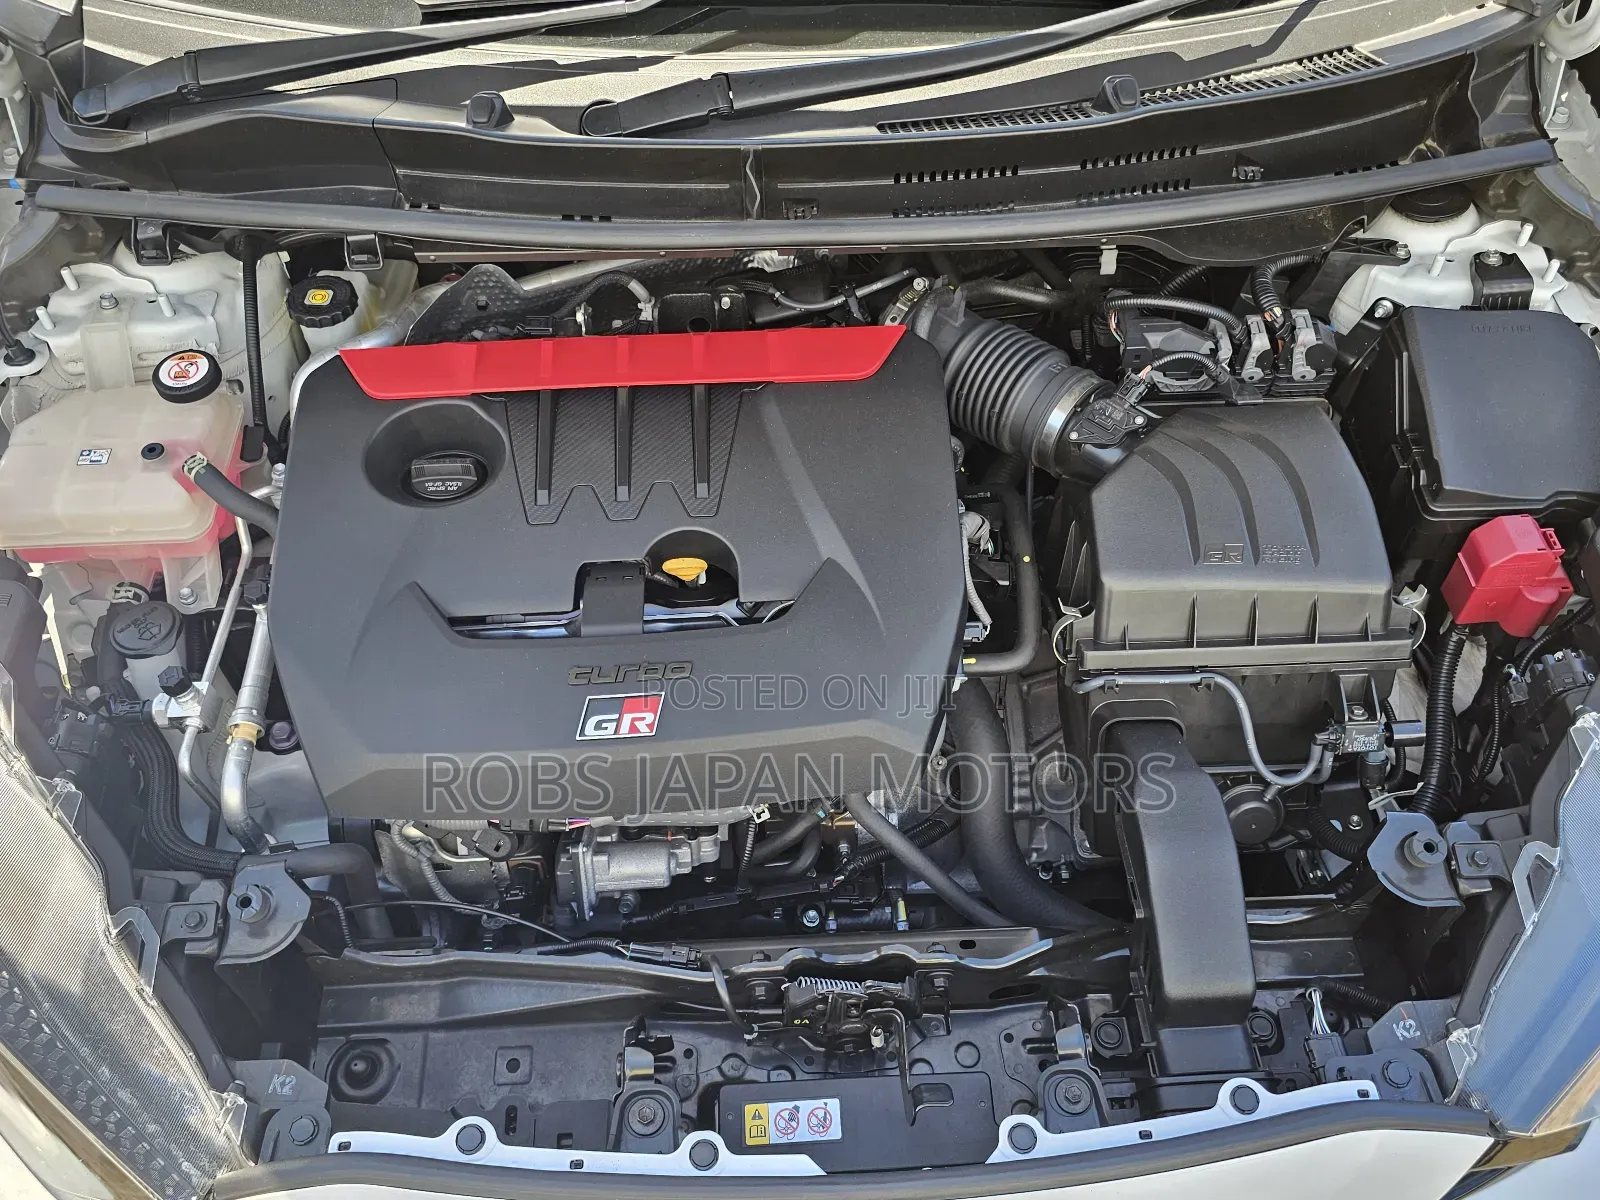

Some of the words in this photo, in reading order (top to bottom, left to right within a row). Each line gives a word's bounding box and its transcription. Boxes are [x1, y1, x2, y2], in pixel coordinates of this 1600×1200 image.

[568, 660, 694, 686] turbo
[584, 712, 655, 736] GR
[1392, 1019, 1421, 1041] K2
[268, 1074, 297, 1095] K2
